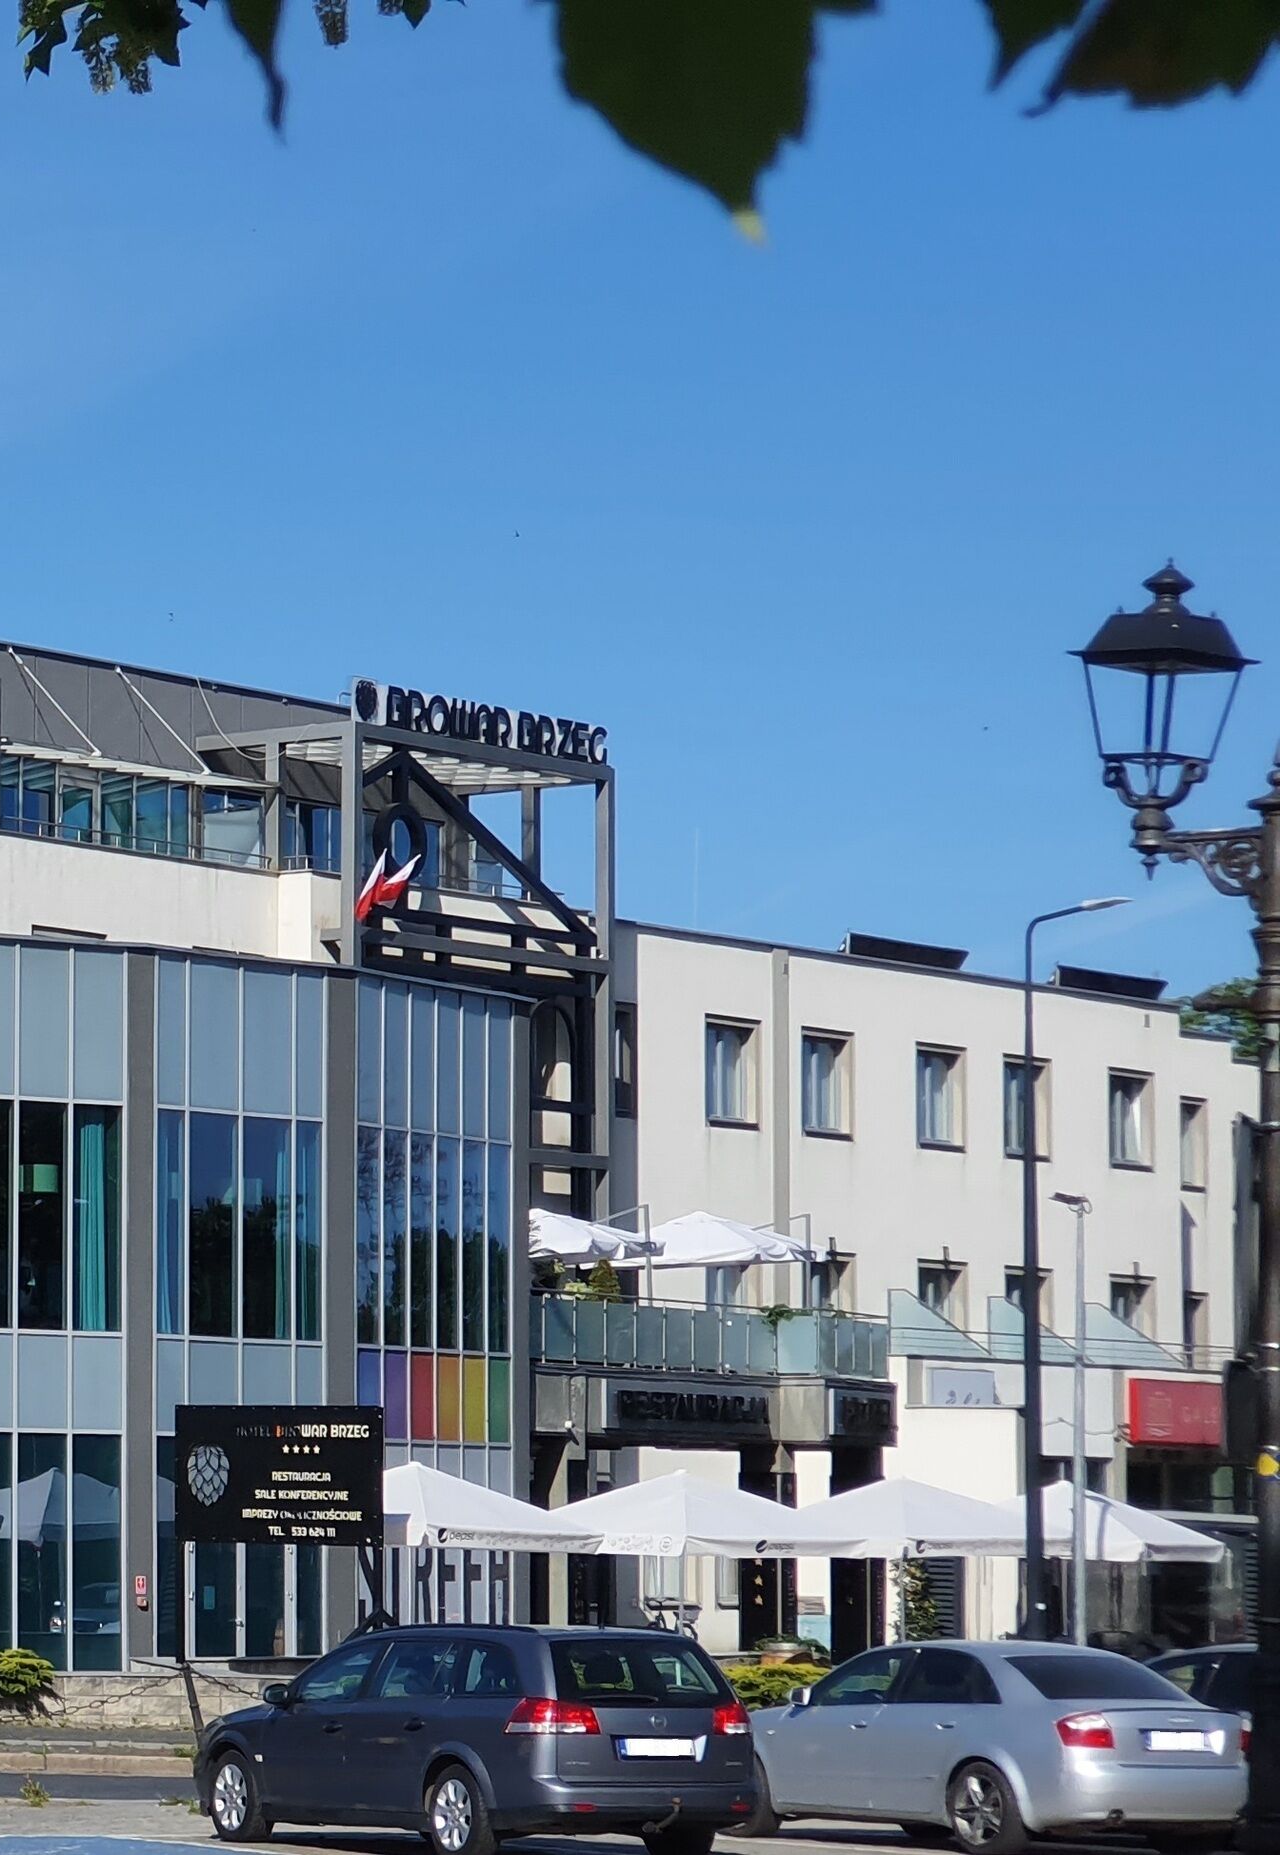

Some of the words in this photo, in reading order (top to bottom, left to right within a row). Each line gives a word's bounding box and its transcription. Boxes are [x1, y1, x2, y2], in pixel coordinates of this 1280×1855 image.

[387, 685, 512, 748] BROWAR
[517, 711, 608, 764] BRZEG
[330, 1424, 370, 1438] BRZEG
[271, 1471, 331, 1482] RESTAURACJA
[254, 1489, 277, 1500] SALE
[278, 1490, 349, 1501] KONFERENCYJNE
[242, 1508, 278, 1520] IMPREZY
[291, 1526, 307, 1537] 533
[308, 1526, 325, 1537] 624
